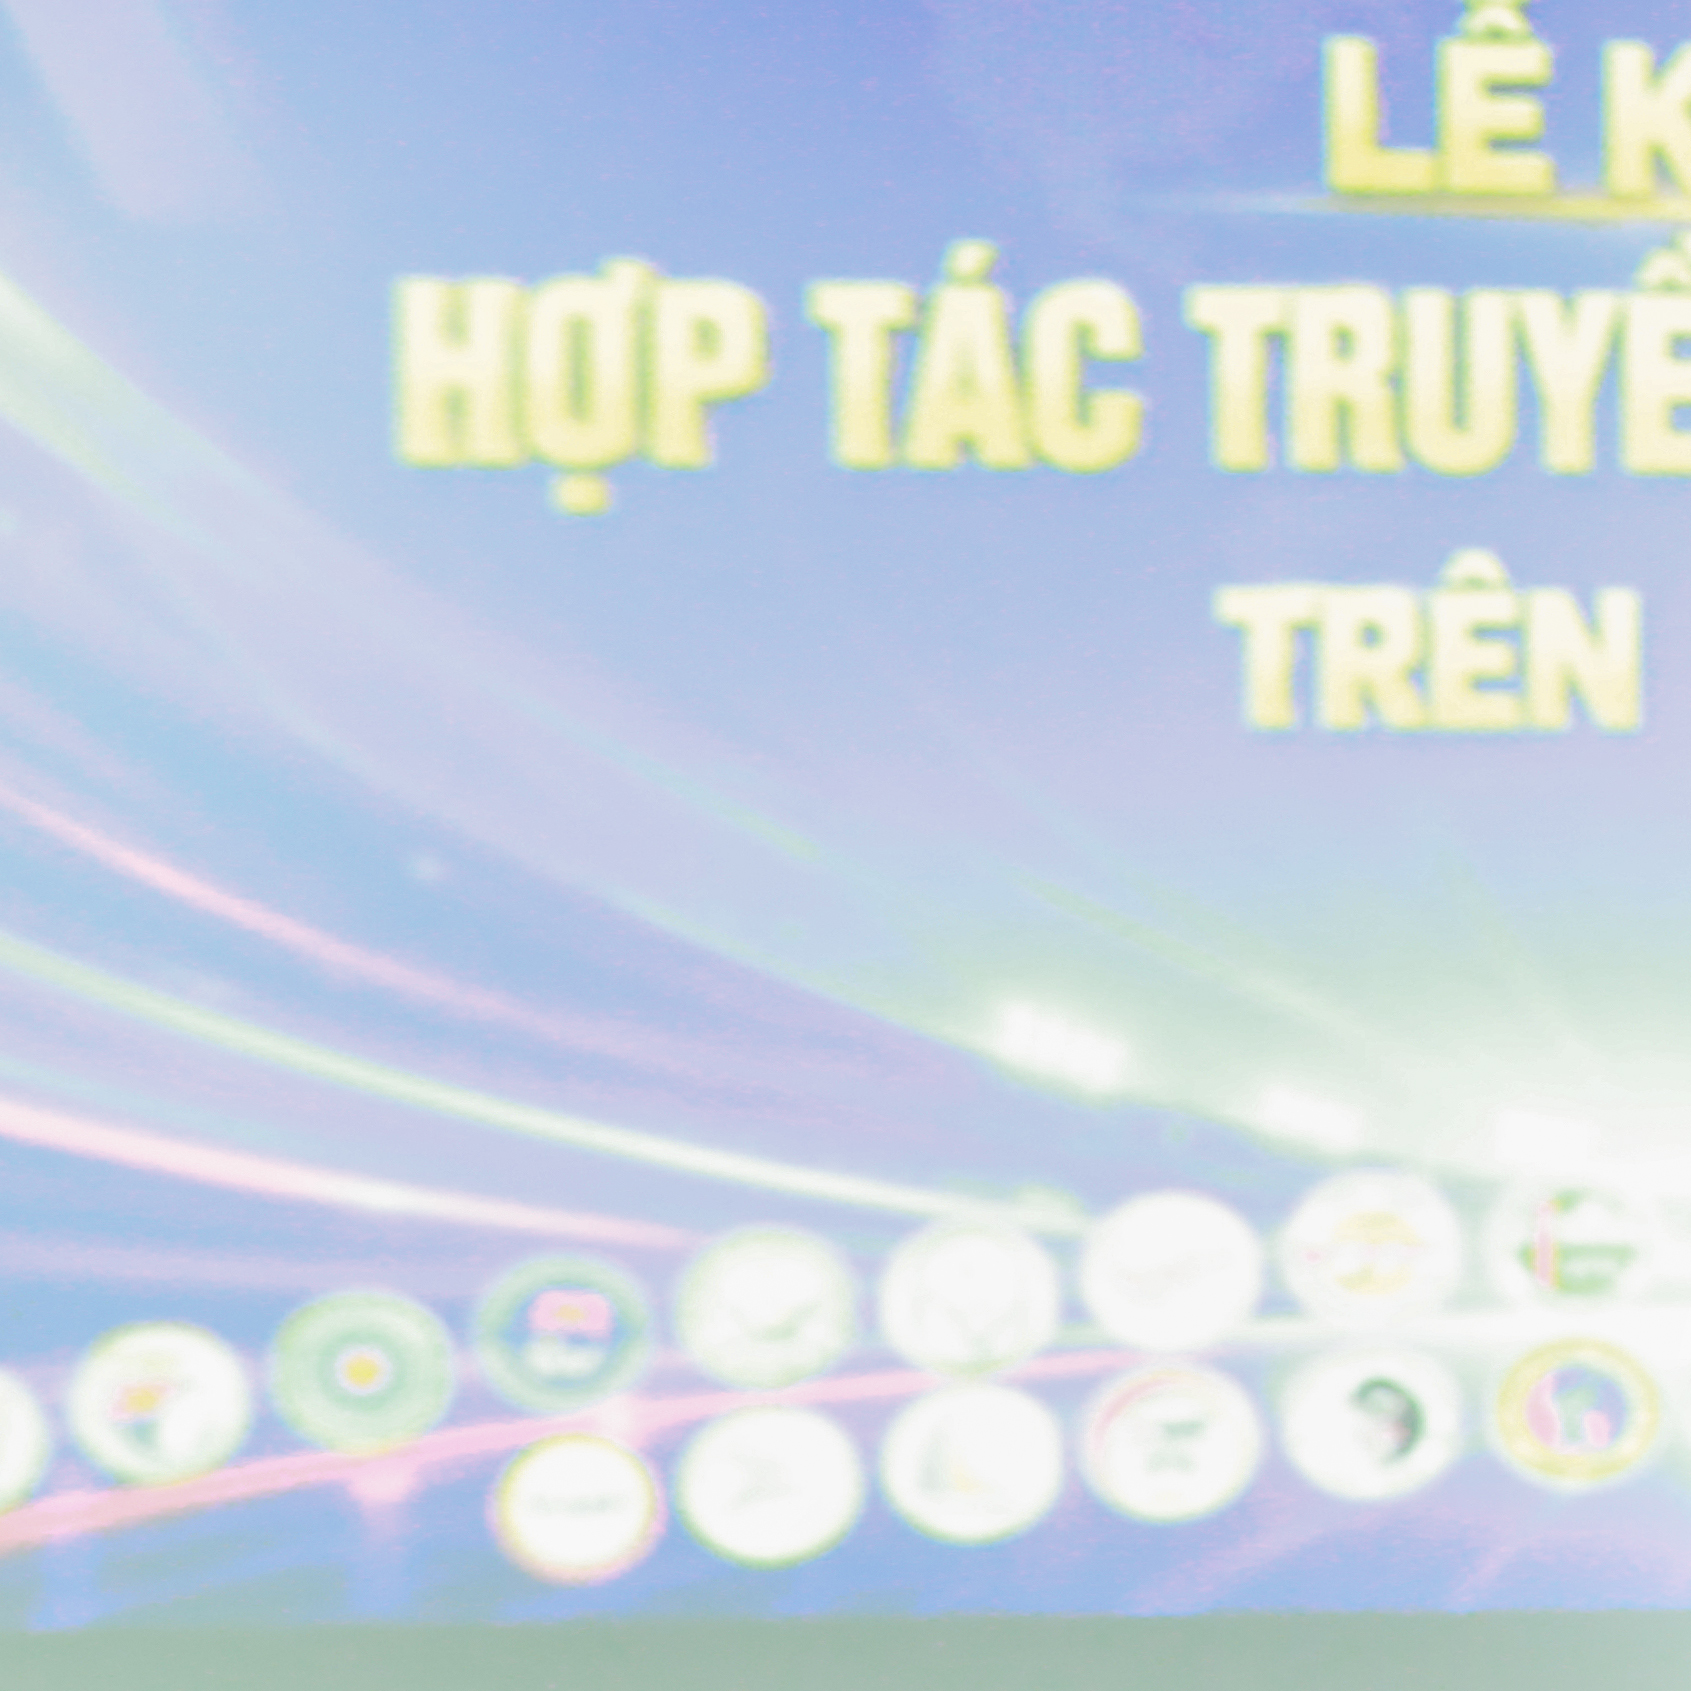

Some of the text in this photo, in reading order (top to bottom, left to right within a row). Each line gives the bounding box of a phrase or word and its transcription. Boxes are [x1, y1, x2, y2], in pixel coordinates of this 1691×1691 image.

[394, 258, 768, 513] HỢP
[810, 242, 1146, 472] TÁC
[1218, 550, 1644, 732] TRÊN
